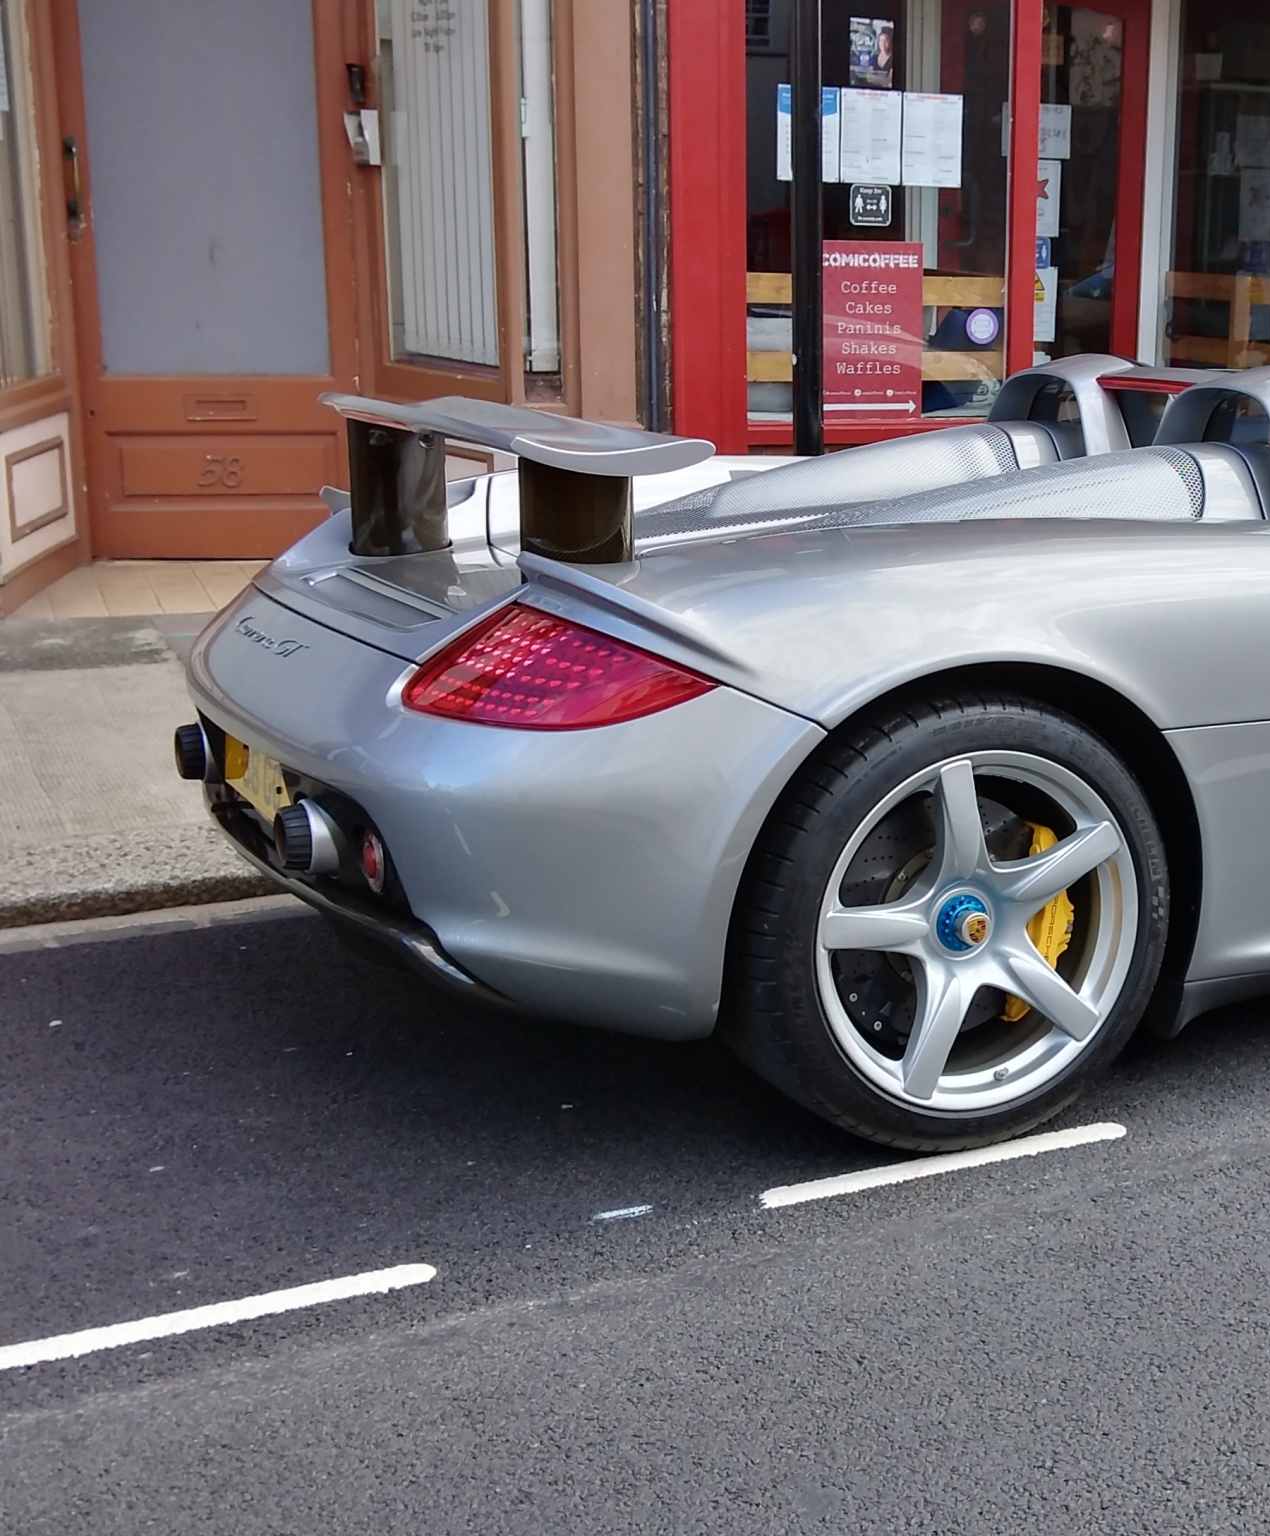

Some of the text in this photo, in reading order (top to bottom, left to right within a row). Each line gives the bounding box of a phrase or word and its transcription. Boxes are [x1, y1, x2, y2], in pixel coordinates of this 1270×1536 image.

[822, 252, 918, 269] COMICOFFEE
[841, 281, 897, 294] Coffee
[845, 301, 893, 314] Cakes
[837, 321, 901, 334] Paninis
[841, 342, 897, 355] Shakes
[836, 362, 901, 375] Waffles
[197, 455, 243, 489] 58
[273, 640, 310, 658] GT
